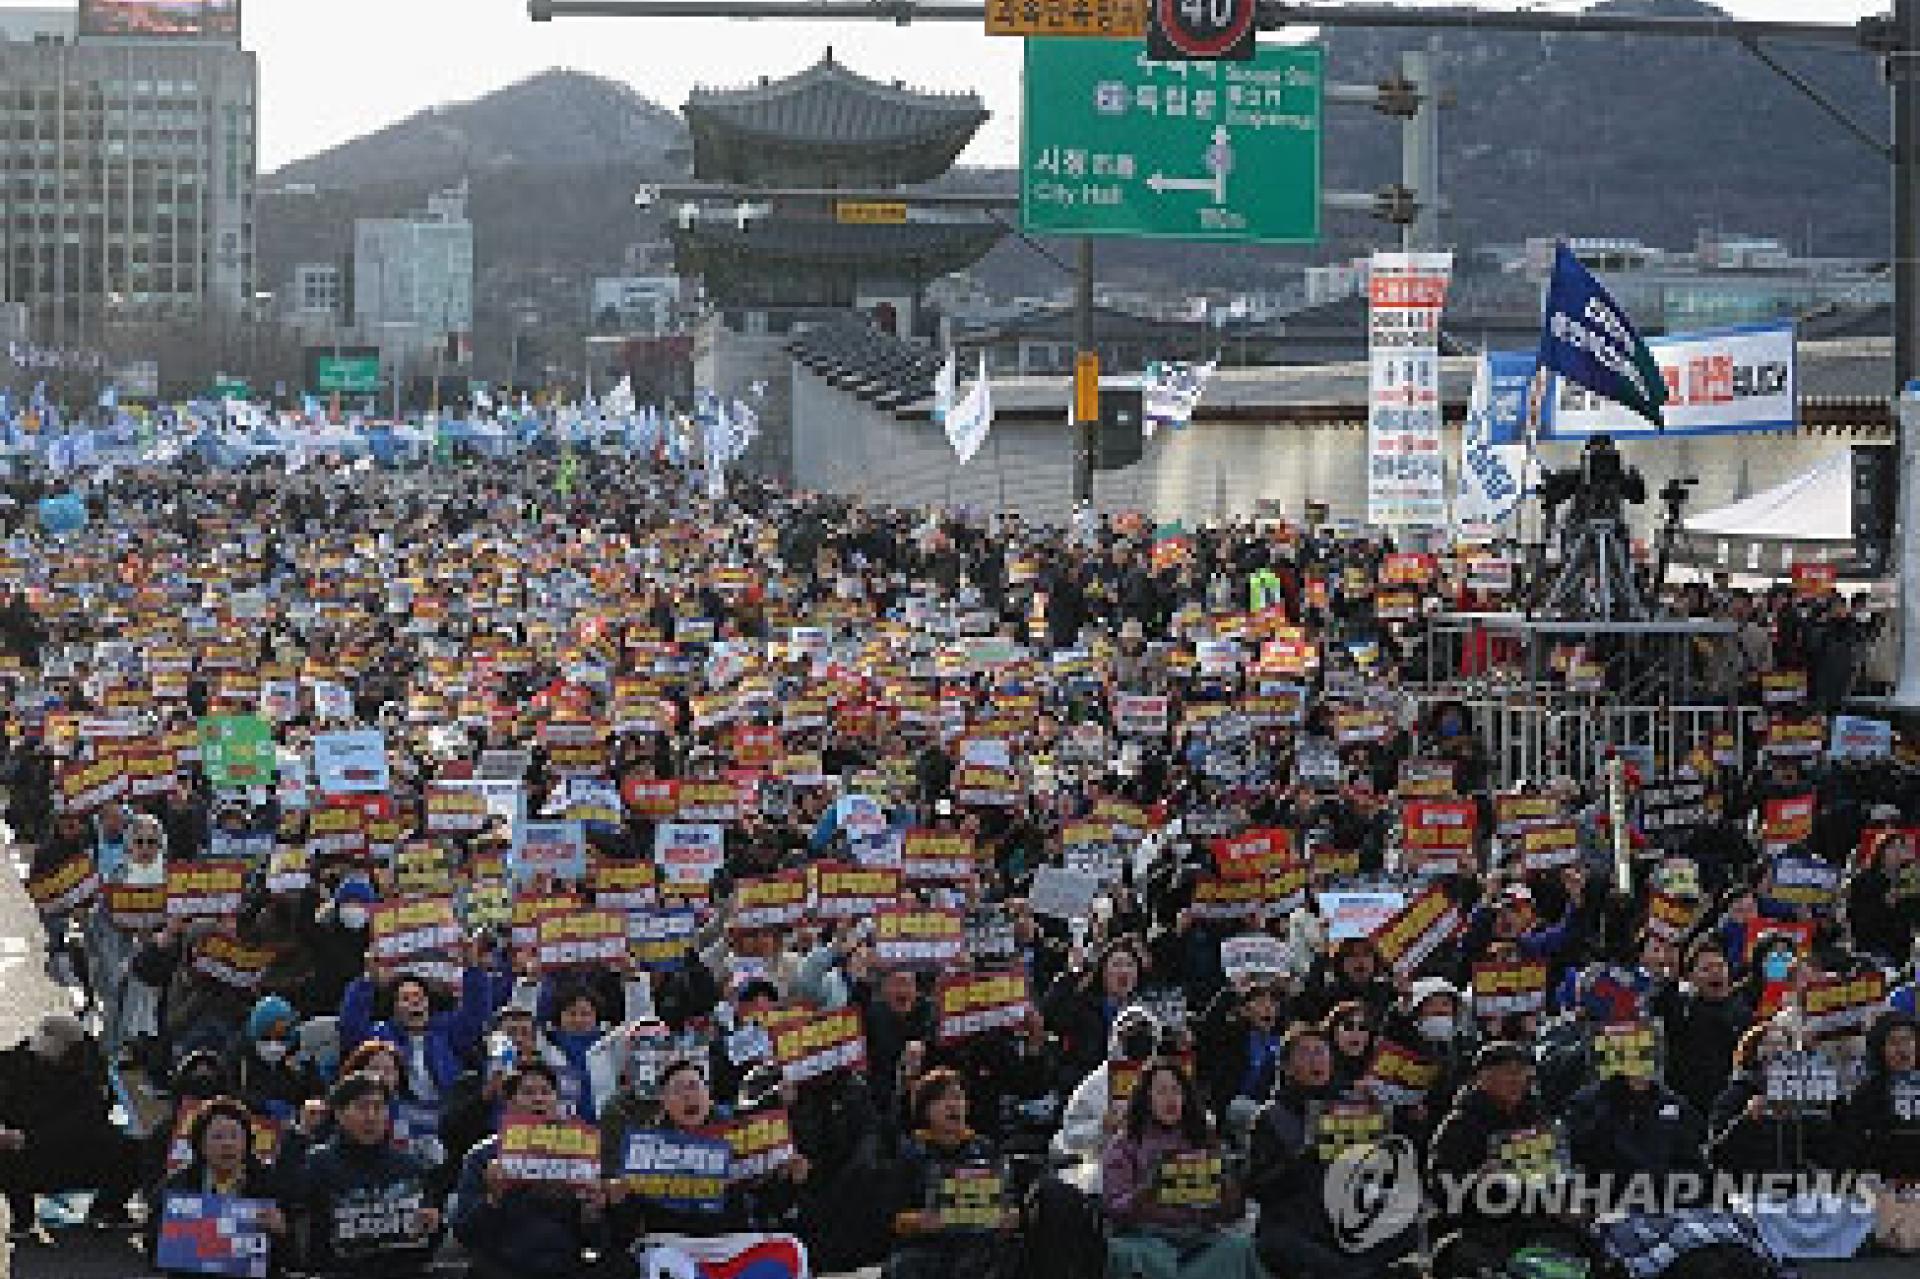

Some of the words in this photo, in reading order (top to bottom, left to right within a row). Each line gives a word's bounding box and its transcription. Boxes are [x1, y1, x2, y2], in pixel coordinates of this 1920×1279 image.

[1181, 0, 1231, 27] 40
[1033, 180, 1075, 208] City
[1081, 183, 1123, 205] Hall
